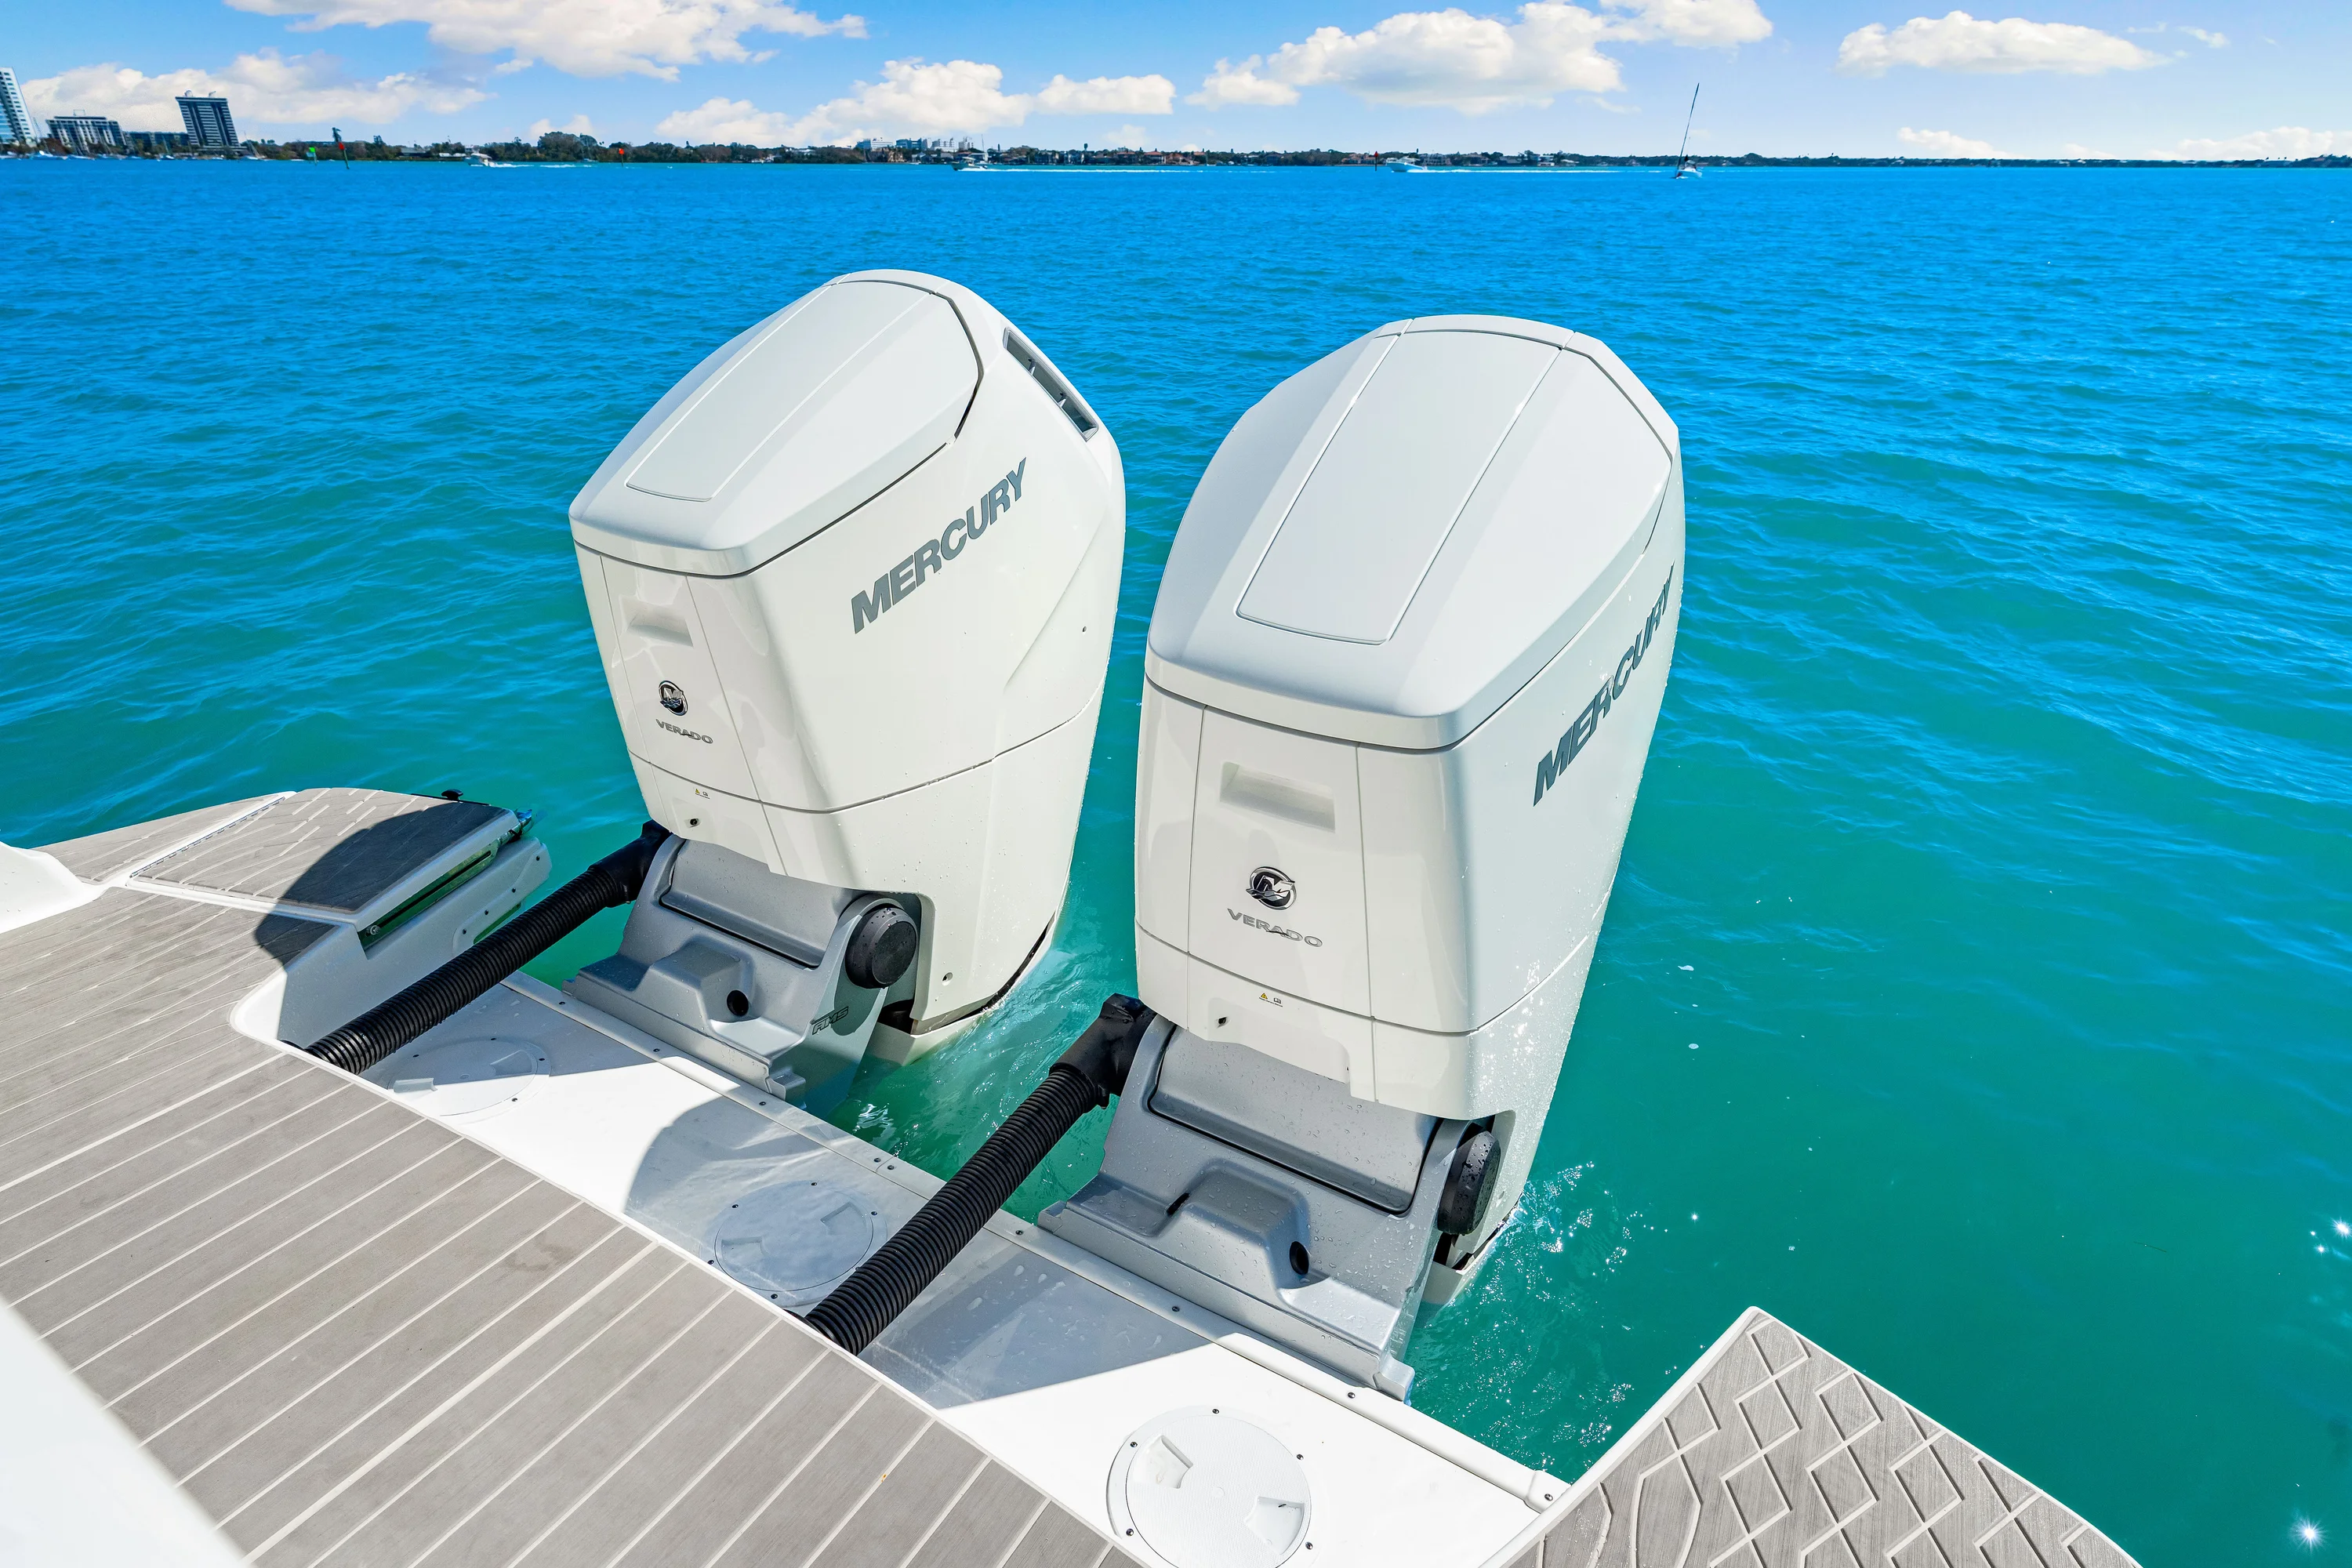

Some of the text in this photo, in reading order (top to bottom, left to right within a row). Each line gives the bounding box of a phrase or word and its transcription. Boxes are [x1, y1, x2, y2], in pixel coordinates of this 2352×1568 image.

[851, 456, 1027, 635] MERCURY
[655, 719, 714, 745] VERADO
[1533, 559, 1675, 808] MERCURY
[1226, 908, 1323, 948] VERADO
